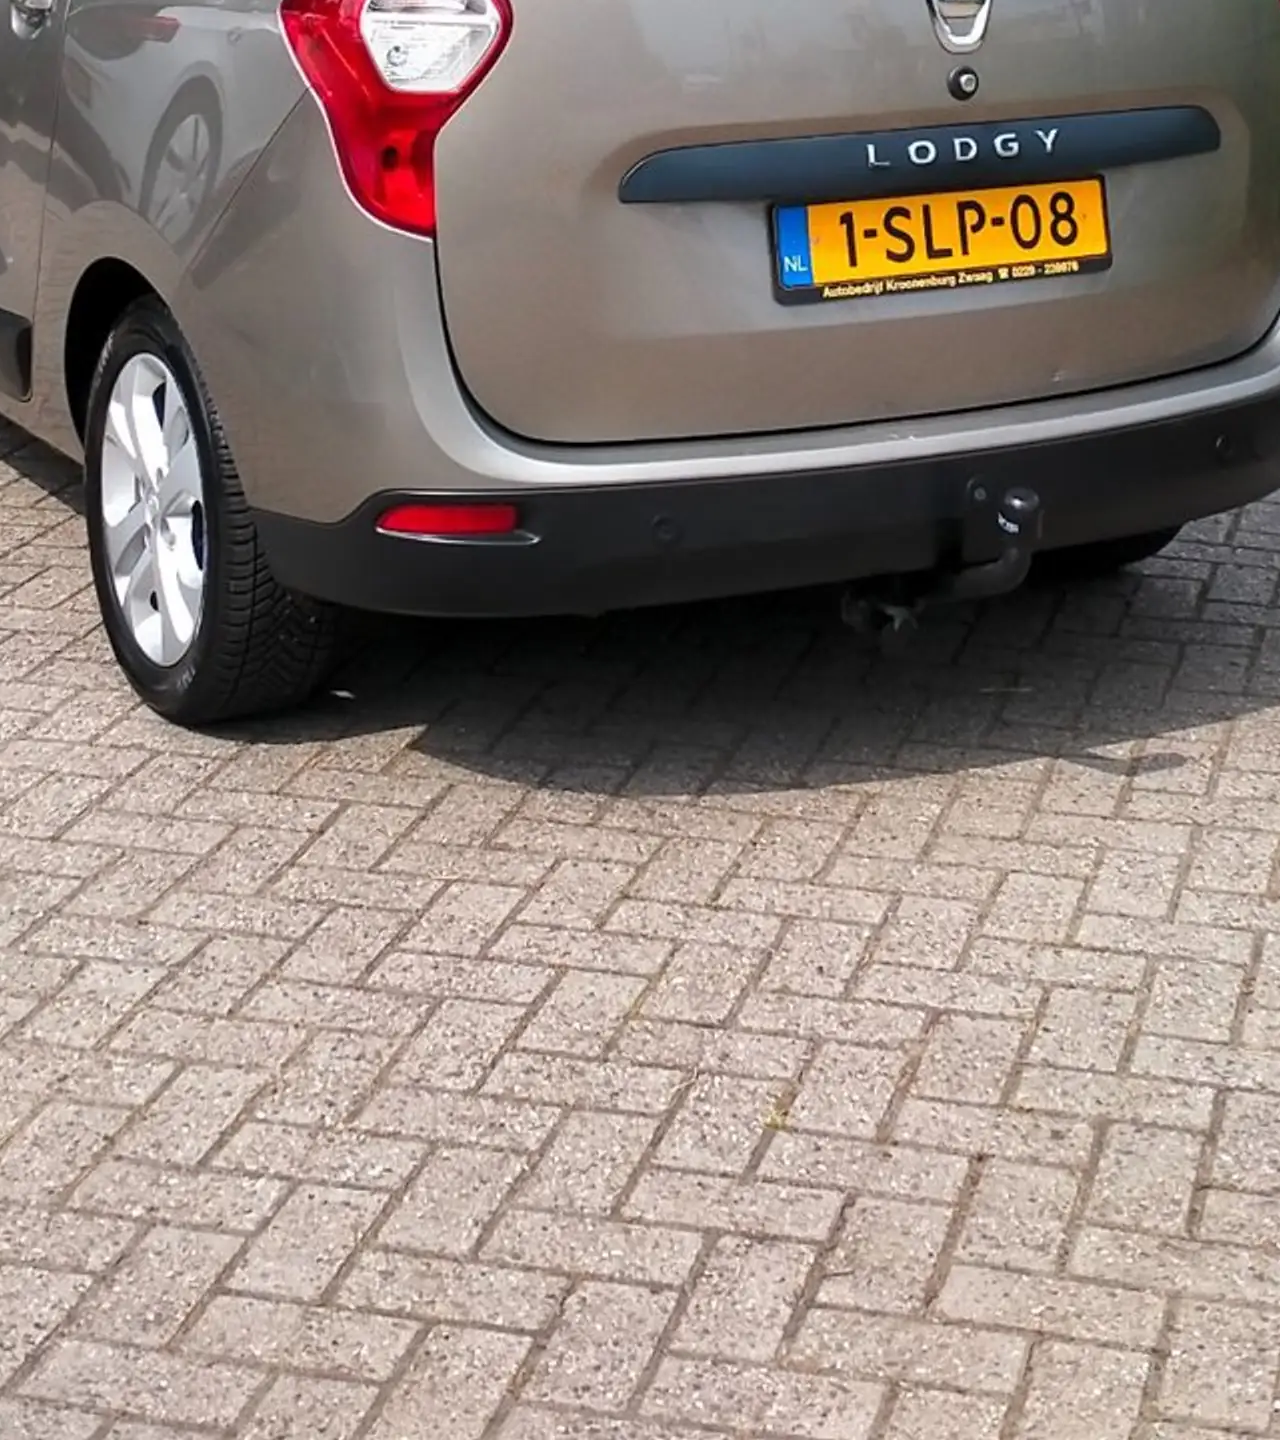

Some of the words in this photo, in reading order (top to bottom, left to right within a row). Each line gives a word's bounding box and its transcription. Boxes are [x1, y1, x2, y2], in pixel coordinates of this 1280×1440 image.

[866, 128, 1060, 168] LODGY
[838, 191, 1079, 268] 1-SLP-08
[783, 254, 808, 273] NL
[822, 279, 883, 298] Autobedrijf
